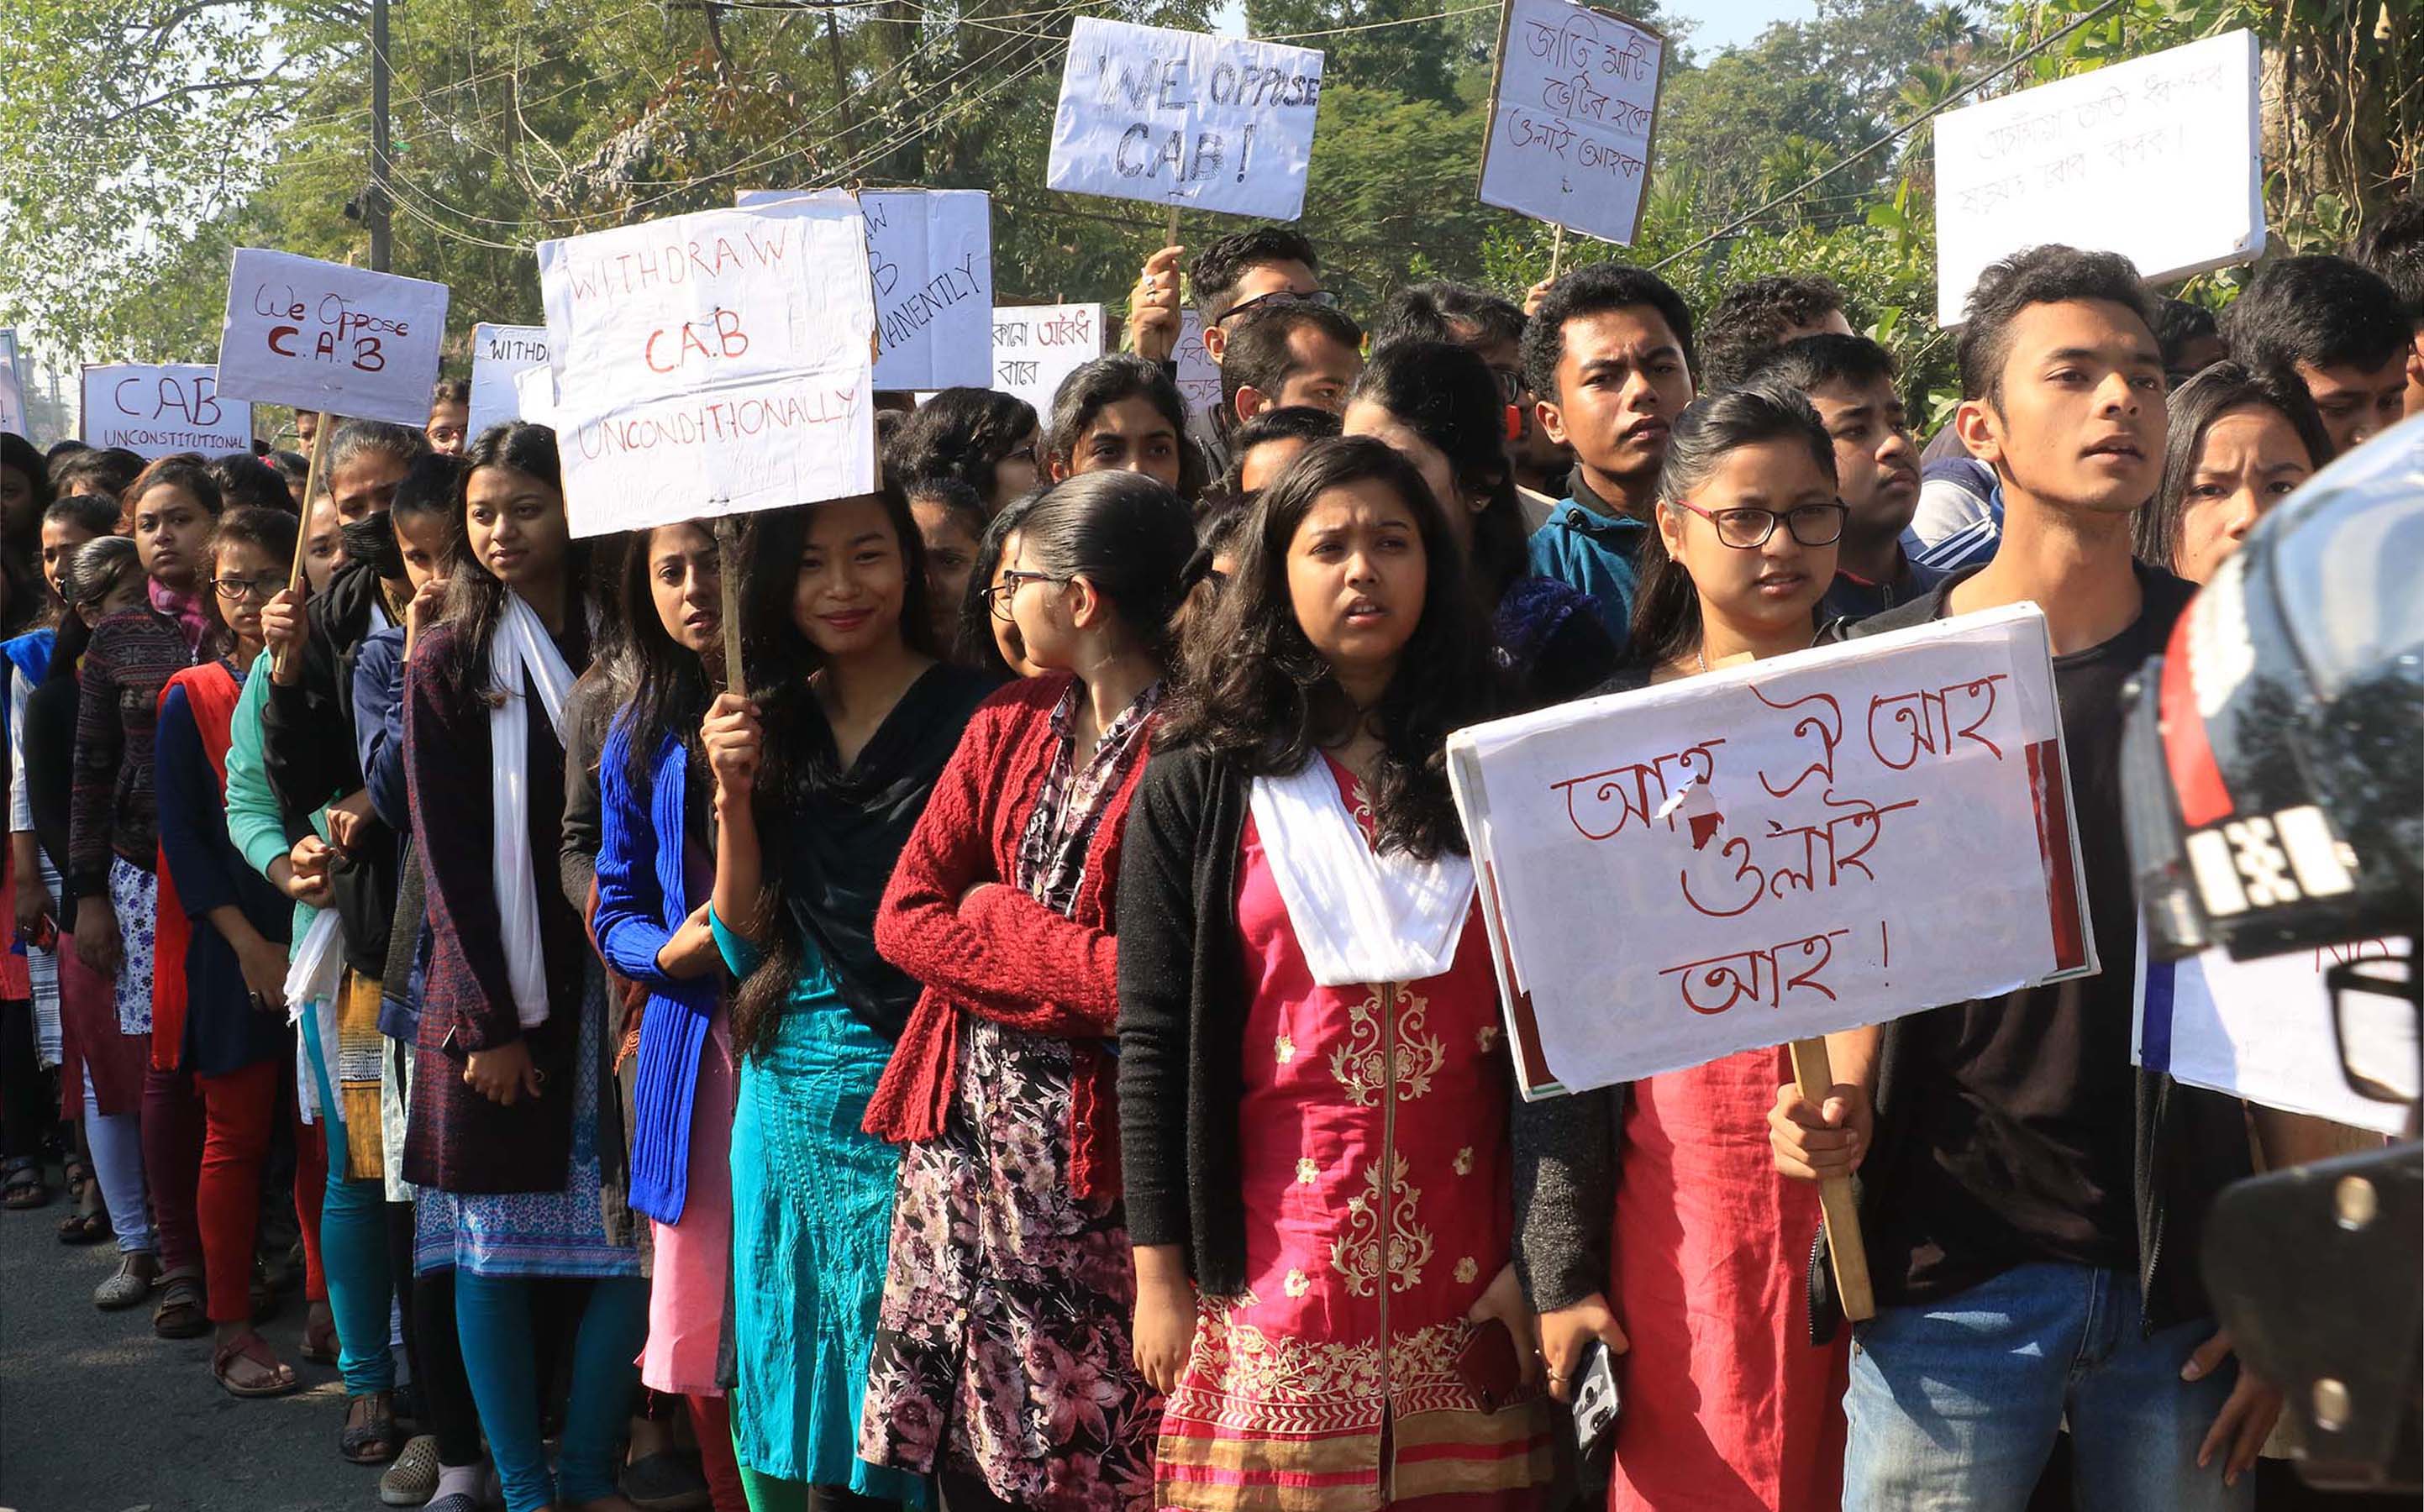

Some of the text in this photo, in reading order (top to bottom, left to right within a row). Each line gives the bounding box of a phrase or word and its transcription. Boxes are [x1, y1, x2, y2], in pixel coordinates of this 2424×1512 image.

[1526, 14, 1654, 81] জাতি মাটি
[1098, 55, 1321, 111] WE OPPOSE
[567, 226, 786, 300] WITHDRAW
[255, 283, 306, 321] We
[876, 254, 981, 355] ANENTLY
[489, 339, 550, 362] WITHD
[115, 377, 222, 426] CAB
[578, 388, 855, 459] UNCONDITIONALLY
[104, 429, 247, 449] UNCONSTITUTIONAL
[1868, 675, 2007, 769] আহ
[1681, 788, 1918, 917] ওলাই
